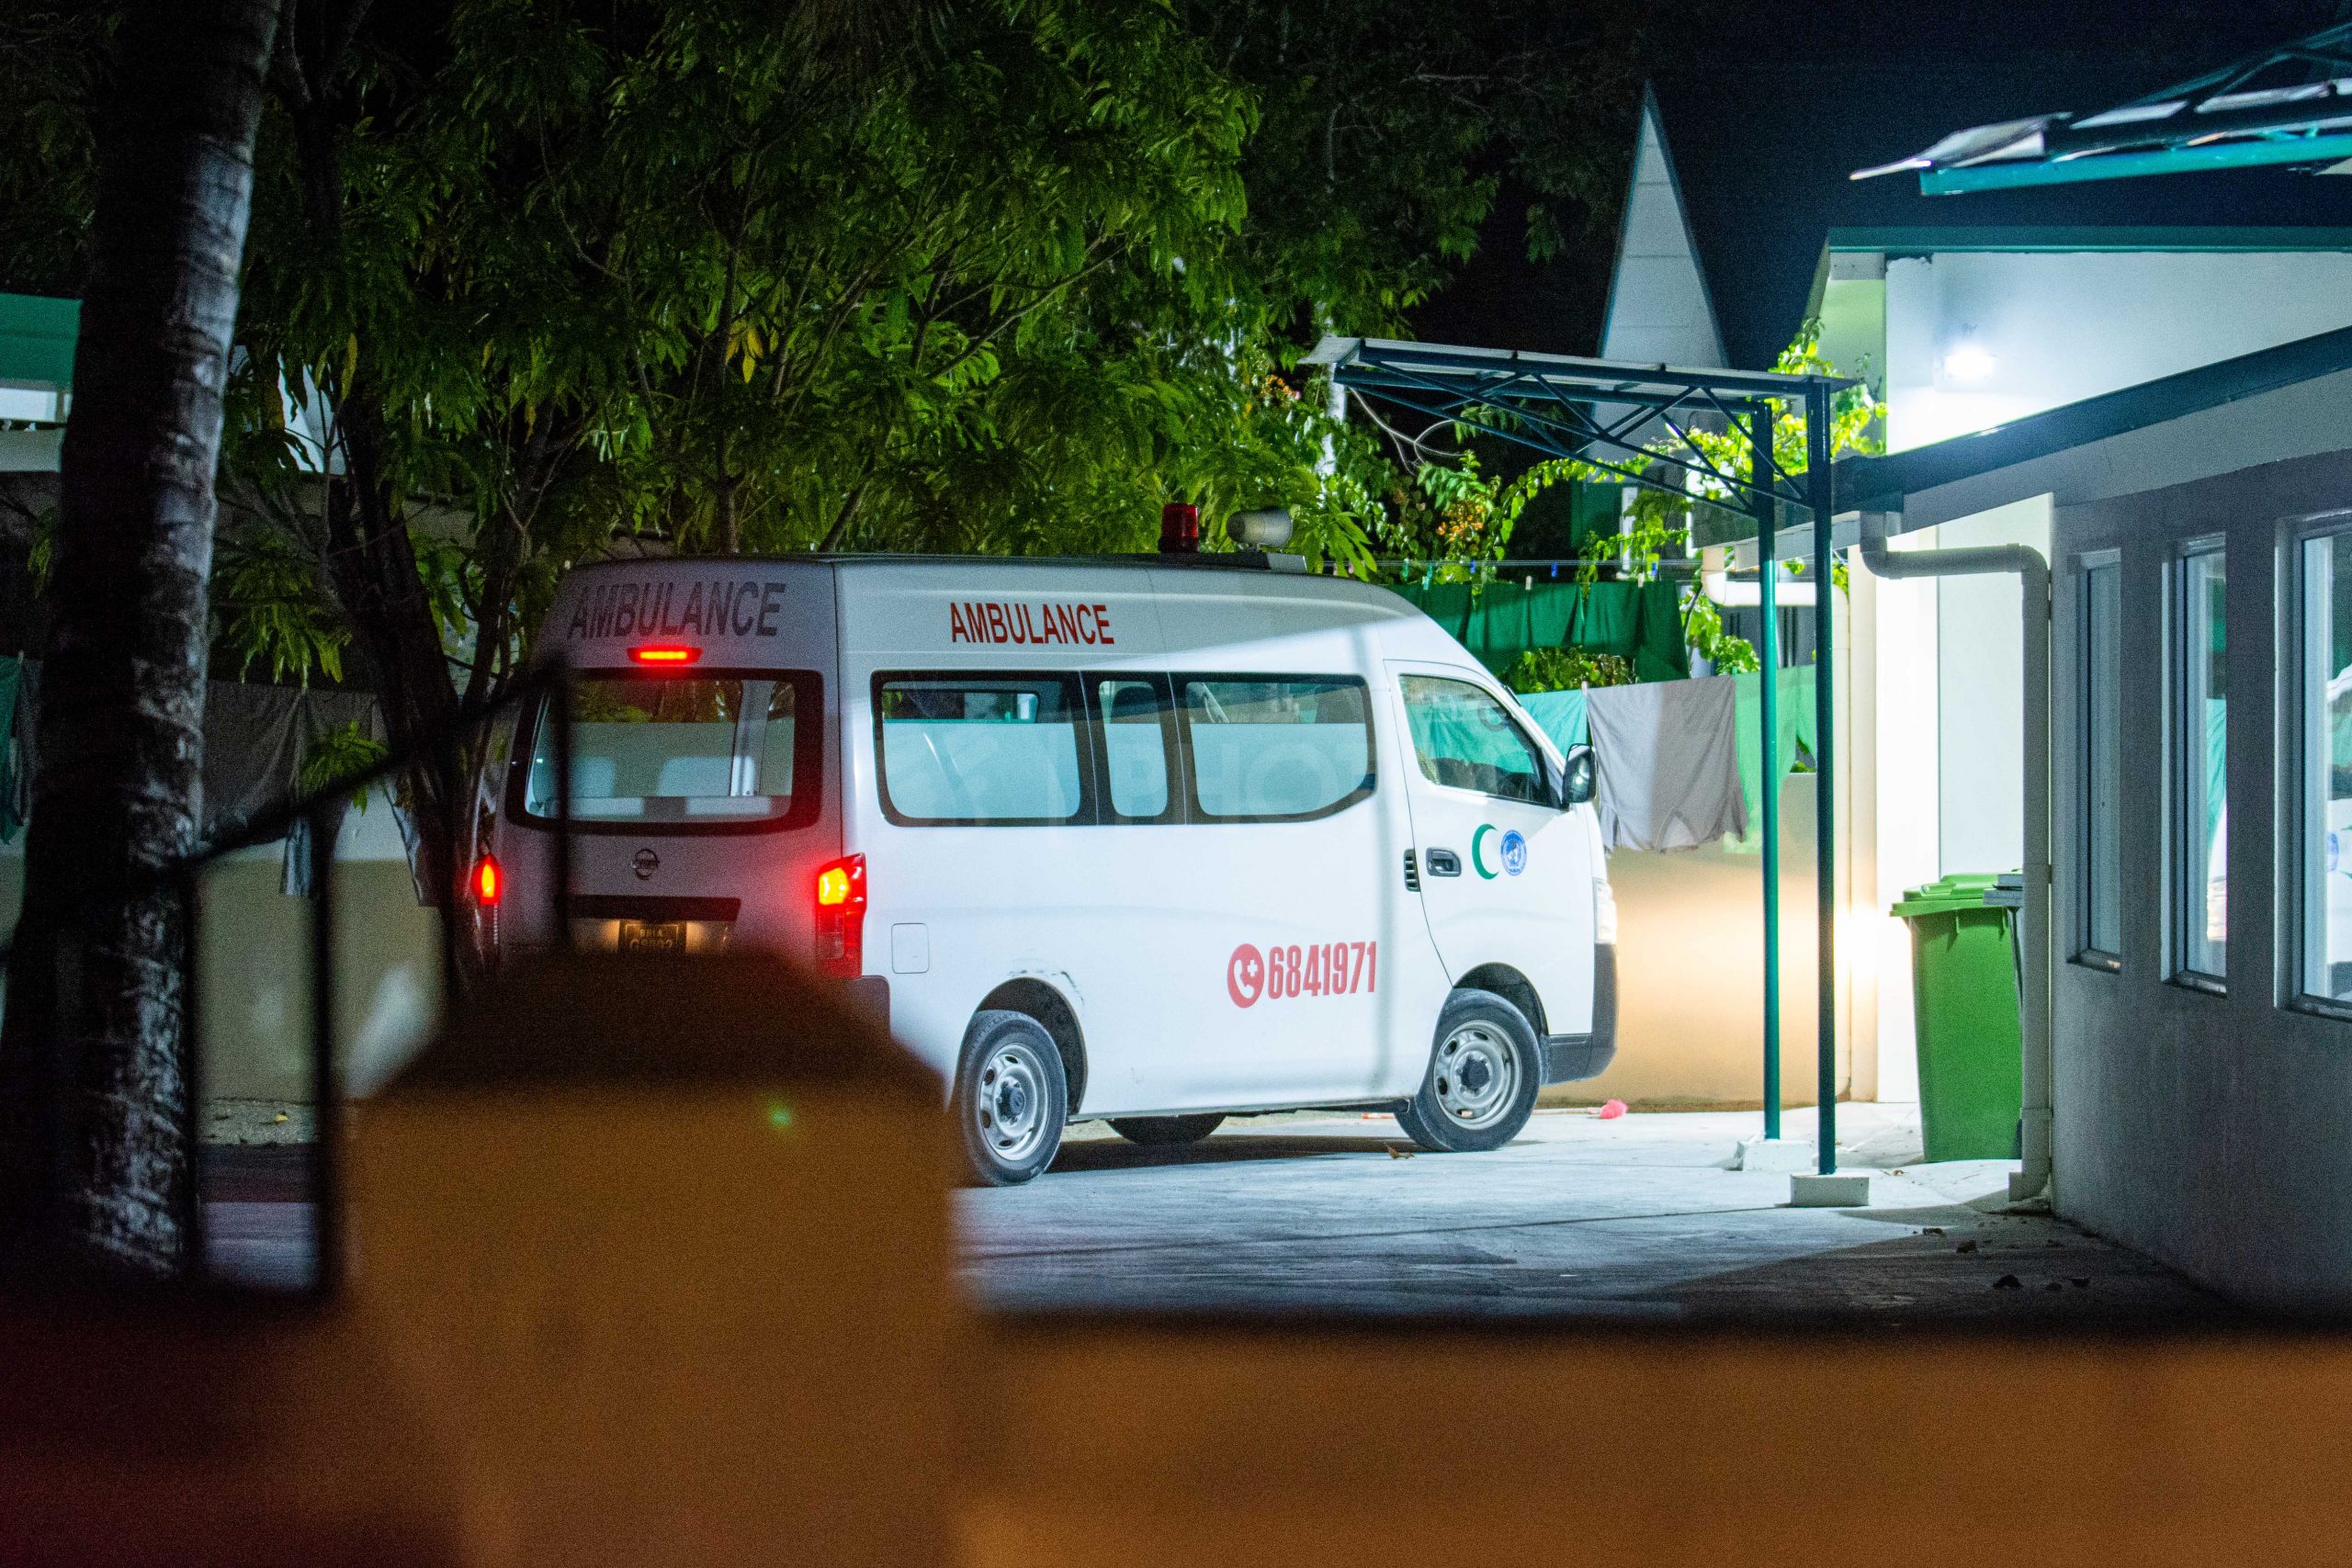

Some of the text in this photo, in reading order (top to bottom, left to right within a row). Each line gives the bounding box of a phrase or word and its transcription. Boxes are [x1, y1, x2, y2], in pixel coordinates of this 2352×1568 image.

[566, 581, 786, 639] AMBULANCE
[950, 602, 1115, 645] AMBULANCE
[1268, 941, 1376, 999] 6841971
